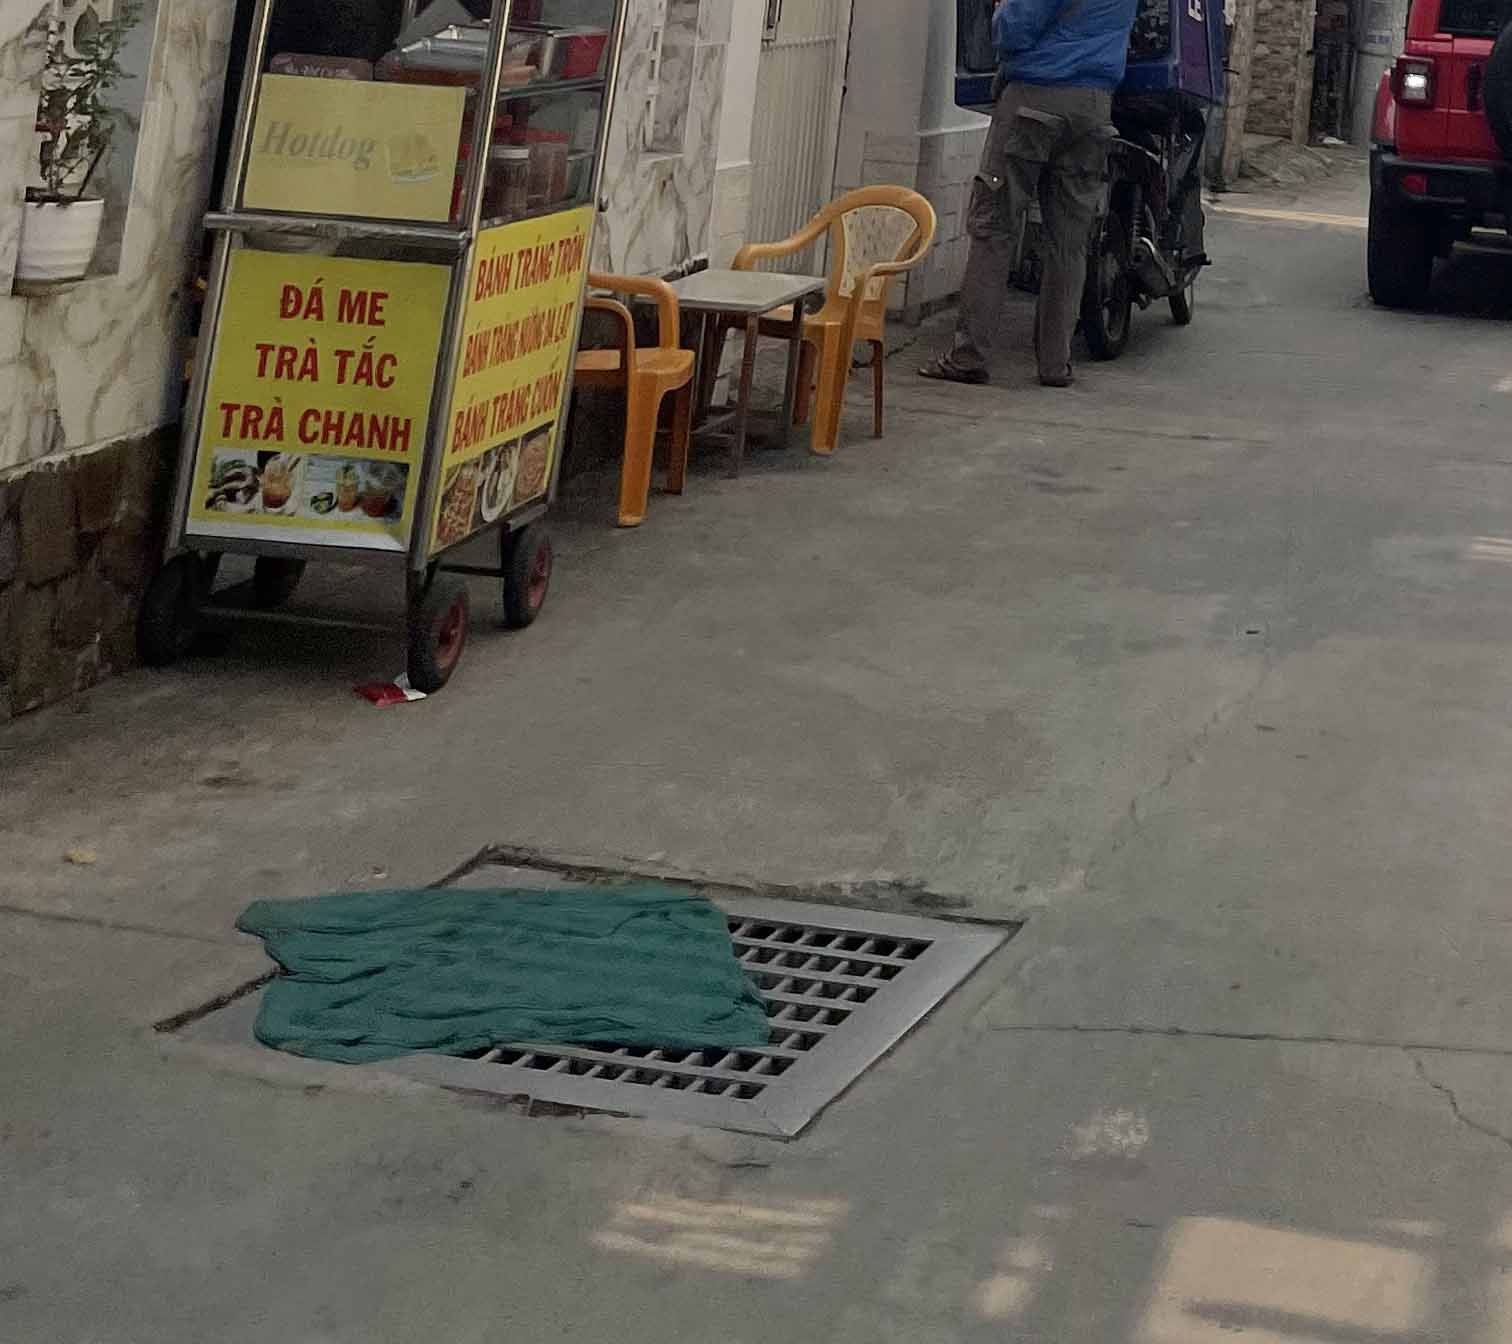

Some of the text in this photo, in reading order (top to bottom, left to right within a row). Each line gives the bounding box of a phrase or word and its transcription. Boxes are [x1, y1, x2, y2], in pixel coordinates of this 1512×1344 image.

[257, 120, 377, 171] Hotdog
[474, 246, 513, 301] BÁNH
[515, 234, 555, 290] TRÁNG
[279, 277, 389, 327] ĐÁ ME
[255, 335, 397, 389] TRÀ TẮC
[219, 396, 412, 452] TRÀ CHANH
